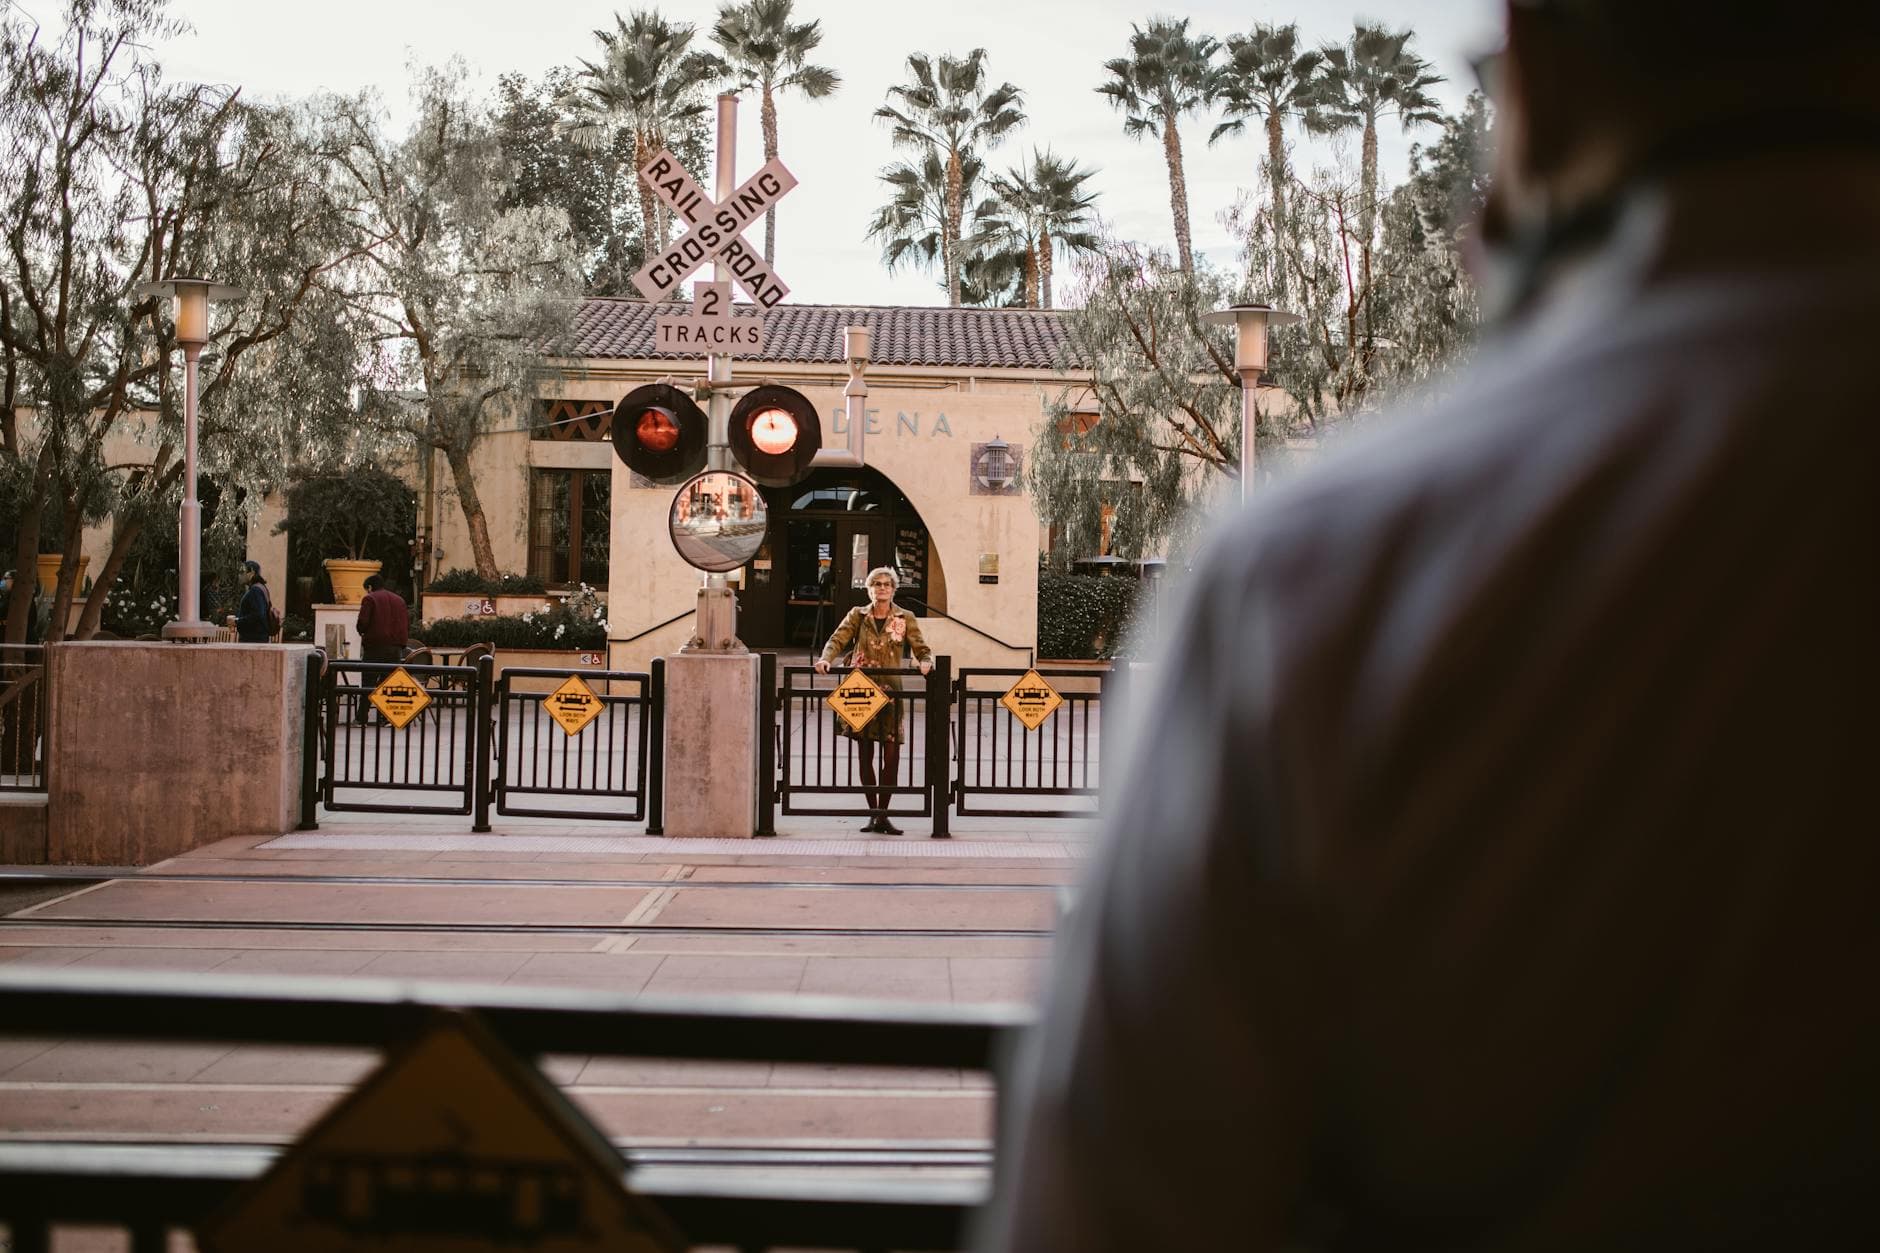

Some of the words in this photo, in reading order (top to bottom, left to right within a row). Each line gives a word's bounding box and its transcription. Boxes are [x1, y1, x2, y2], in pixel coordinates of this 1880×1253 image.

[647, 157, 702, 224] RAIL
[719, 239, 784, 309] ROAD
[648, 172, 781, 290] CROSSING
[662, 325, 759, 344] TRACKS
[701, 290, 719, 316] 2
